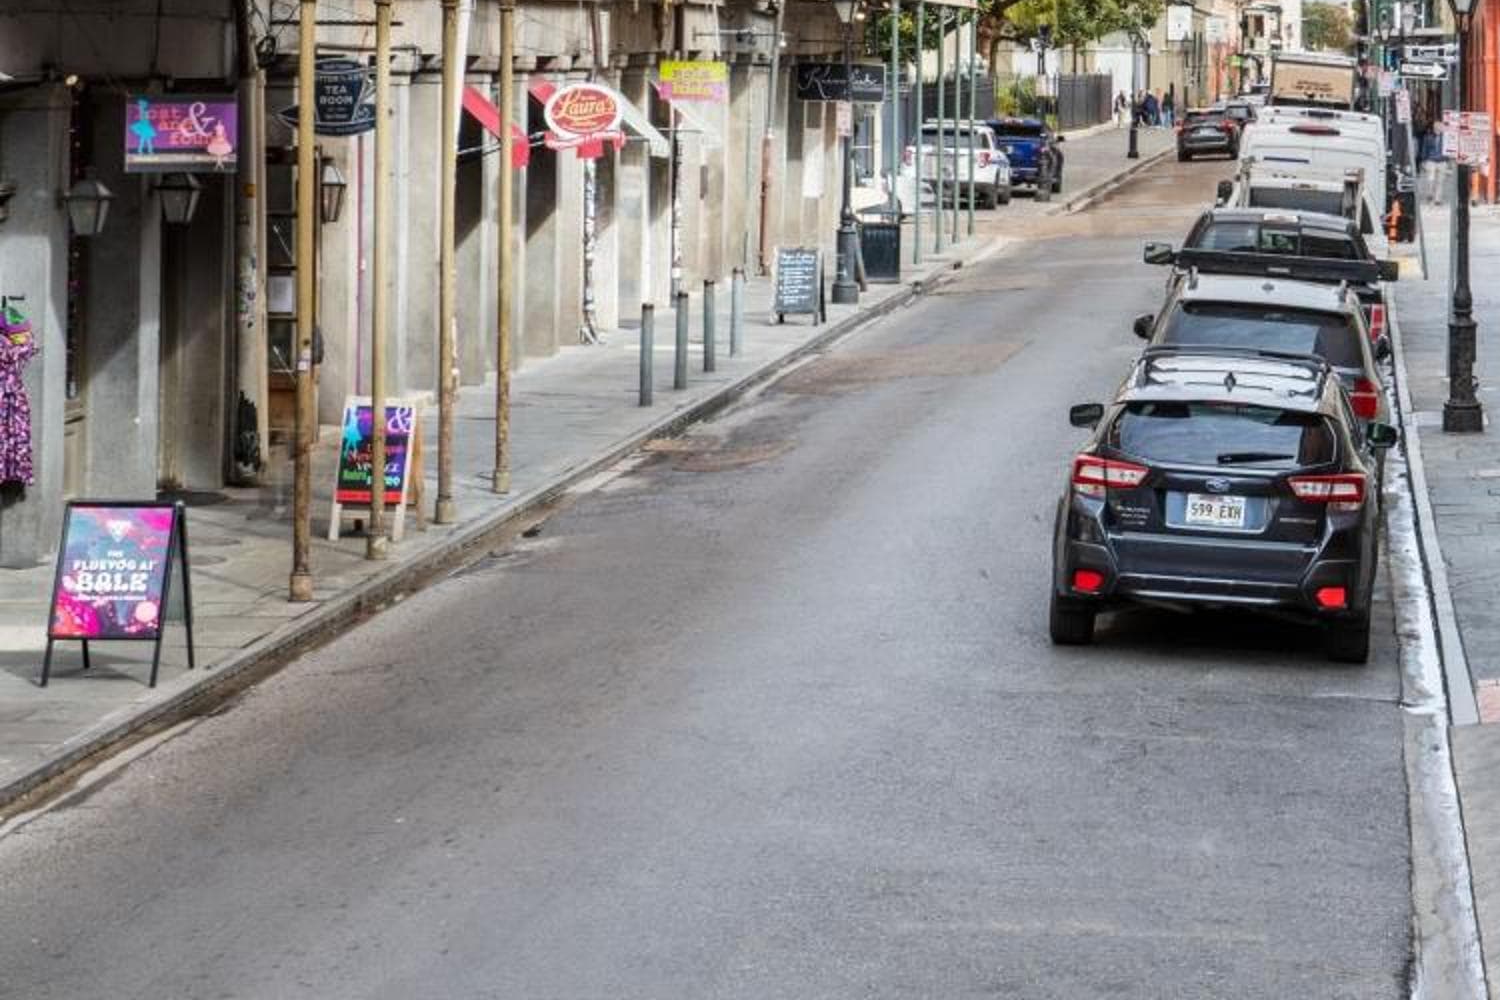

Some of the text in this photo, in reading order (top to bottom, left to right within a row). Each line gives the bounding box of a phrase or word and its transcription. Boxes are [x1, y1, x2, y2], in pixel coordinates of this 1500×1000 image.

[324, 85, 348, 95] TEA
[320, 96, 353, 105] ROOM
[551, 88, 616, 120] Laura's
[179, 101, 216, 137] &
[168, 131, 213, 145] foun
